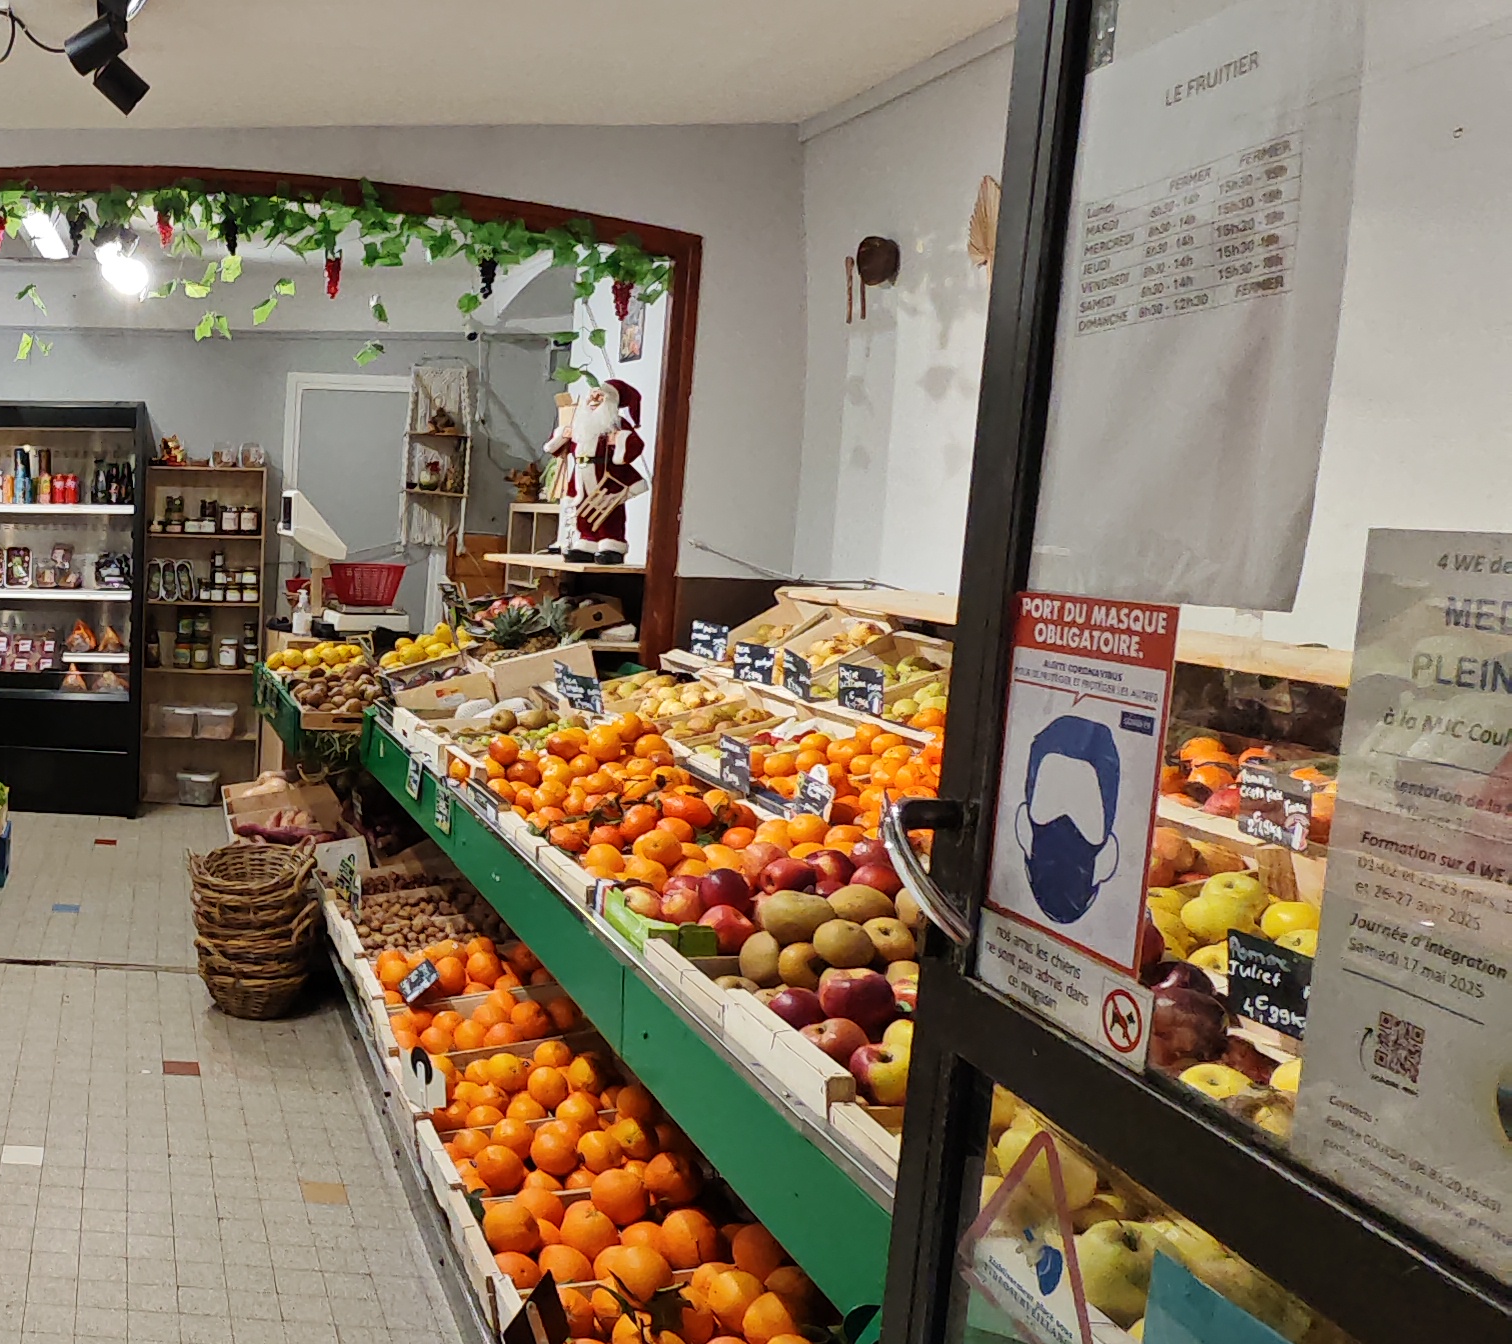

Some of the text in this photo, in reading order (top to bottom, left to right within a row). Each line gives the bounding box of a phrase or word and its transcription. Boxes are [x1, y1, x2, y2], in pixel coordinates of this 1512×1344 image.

[1164, 50, 1260, 107] LE FRUITIER
[1083, 232, 1135, 256] MERCREDI
[1080, 272, 1131, 294] VENDREDI
[1078, 310, 1128, 332] DIMANCHE
[1437, 553, 1448, 570] 4
[1453, 554, 1486, 573] WE
[1021, 596, 1168, 635] PORT DU MASQUE
[1033, 622, 1144, 659] OBLIGATOIRE.
[1420, 715, 1465, 739] MJC
[1360, 829, 1437, 863] Formation
[1440, 853, 1463, 870] sur
[1465, 858, 1475, 872] 4
[1349, 912, 1409, 944] Journée
[995, 926, 1011, 943] nos
[1050, 952, 1082, 980] chiens
[1347, 936, 1399, 966] Samedi
[1420, 963, 1447, 985] mai
[1007, 973, 1059, 1012] ce magasin
[1035, 967, 1063, 993] admis
[1065, 981, 1090, 1007] dans
